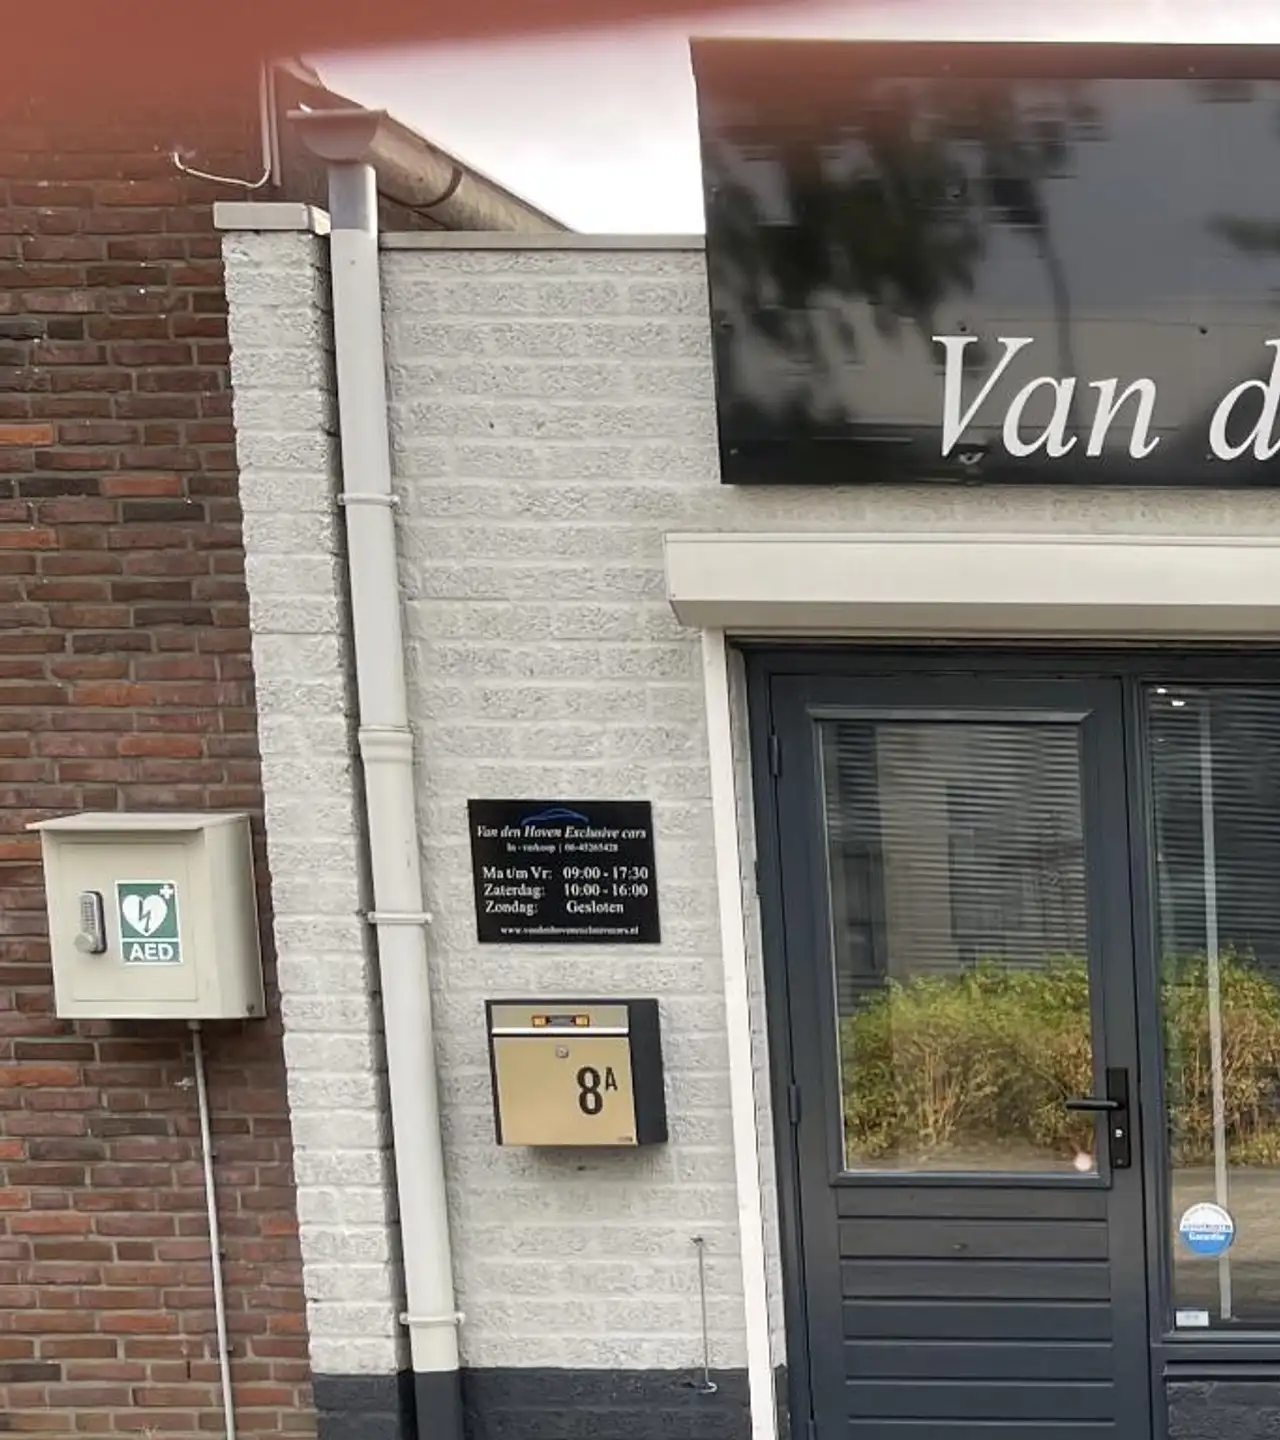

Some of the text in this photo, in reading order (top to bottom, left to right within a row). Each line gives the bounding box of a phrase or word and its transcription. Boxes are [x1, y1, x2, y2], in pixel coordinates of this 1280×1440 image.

[931, 334, 1158, 461] Van
[477, 825, 647, 839] Van den Hoven Exclusive cars
[482, 866, 504, 879] Ma
[530, 866, 552, 880] Vr:
[562, 866, 600, 880] 09:00
[612, 866, 648, 880] 17:30
[484, 883, 545, 899] Zaterdag:
[564, 883, 600, 897] 10:00
[612, 883, 648, 897] 16:00
[485, 900, 624, 916] Zondag: Gesloten
[129, 943, 174, 961] AED
